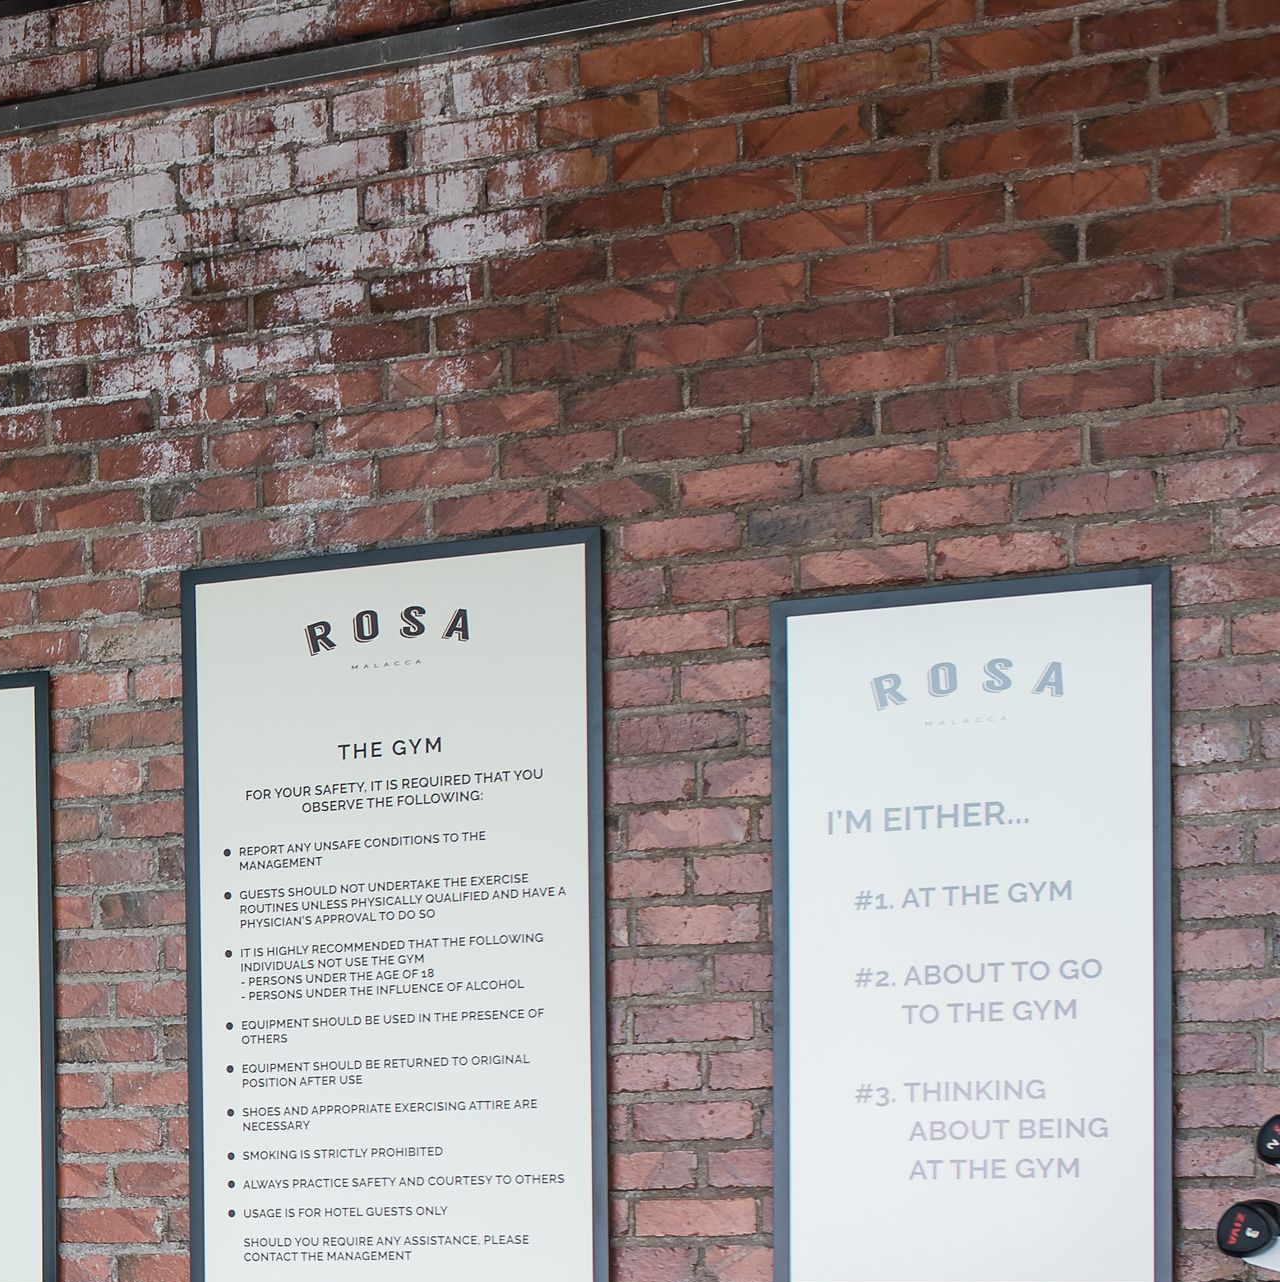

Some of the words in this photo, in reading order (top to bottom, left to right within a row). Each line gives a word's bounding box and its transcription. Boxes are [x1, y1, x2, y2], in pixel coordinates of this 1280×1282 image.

[304, 605, 469, 656] ROSA
[351, 659, 421, 669] MALACCA
[869, 657, 1064, 711] ROSA
[924, 716, 1006, 725] MALACCA
[337, 741, 382, 760] THE
[392, 736, 442, 755] GYM
[245, 788, 271, 801] FOR
[274, 785, 311, 798] YOUR
[314, 781, 367, 795] SAFETY,
[370, 780, 383, 791] IT
[386, 779, 398, 790] IS
[401, 773, 471, 789] REQUIRED
[473, 770, 511, 784] THAT
[513, 768, 543, 781] YOU
[301, 798, 364, 813] OBSERVE
[365, 795, 393, 808] THE
[396, 789, 483, 806] FOLLOWING:
[883, 800, 1029, 832] EITHER...
[239, 843, 285, 856] REPORT
[286, 842, 311, 853] ANY
[313, 838, 361, 851] UNSAFE
[363, 833, 439, 848] CONDITIONS
[441, 832, 459, 842] TO
[461, 830, 486, 841] THE
[239, 856, 323, 871] MANAGEMENT
[239, 887, 285, 900] GUESTS
[287, 884, 337, 897] SHOULD
[340, 882, 365, 894] NOT
[367, 878, 440, 892] UNDERTAKE
[442, 876, 467, 887] THE
[470, 872, 528, 886] EXERCISE
[853, 889, 894, 910] #1.
[900, 886, 936, 908] AT
[941, 883, 999, 906] THE
[1007, 879, 1072, 903] GYM
[239, 901, 298, 914] ROUTINES
[301, 898, 348, 910] UNLESS
[350, 894, 423, 908] PHYSICALLY
[425, 890, 489, 903] QUALIFIED
[492, 888, 519, 900] AND
[522, 886, 555, 898] HAVE
[557, 886, 566, 896] A
[314, 912, 377, 924] APPROVAL
[378, 910, 395, 920] TO
[398, 909, 416, 920] DO
[418, 908, 435, 919] SO
[240, 947, 251, 957] IT
[253, 947, 263, 957] IS
[266, 945, 309, 956] HIGHLY
[311, 939, 405, 954] RECOMMENDED
[407, 937, 439, 949] THAT
[441, 936, 466, 947] THE
[469, 932, 543, 946] FOLLOWING
[240, 959, 314, 972] INDIVIDUALS
[317, 957, 342, 968] NOT
[345, 956, 368, 967] USE
[370, 955, 395, 965] THE
[397, 953, 424, 964] GYM
[854, 967, 896, 987] #2.
[903, 961, 1005, 986] ABOUT
[1010, 960, 1050, 982] TO
[1058, 958, 1102, 980] GO
[248, 974, 303, 986] PERSONS
[305, 972, 346, 983] UNDER
[349, 970, 373, 981] THE
[375, 969, 399, 980] AGE
[402, 968, 418, 979] OF
[420, 968, 434, 978] 18
[248, 989, 303, 1000] PERSONS
[305, 986, 347, 998] UNDER
[349, 985, 373, 996] THE
[376, 982, 444, 995] INFLUENCE
[446, 981, 463, 991] OF
[465, 979, 525, 990] ALCOHOL
[241, 1017, 310, 1030] EQUIPMENT
[312, 1015, 362, 1027] SHOULD
[364, 1014, 380, 1025] BE
[383, 1013, 415, 1024] USED
[418, 1012, 431, 1023] IN
[433, 1011, 458, 1022] THE
[461, 1008, 524, 1021] PRESENCE
[527, 1007, 544, 1018] OF
[901, 1003, 940, 1024] TO
[946, 1001, 1004, 1023] THE
[1012, 998, 1077, 1021] GYM
[241, 1061, 310, 1073] EQUIPMENT
[312, 1059, 362, 1071] SHOULD
[365, 1059, 380, 1069] BE
[383, 1056, 449, 1068] RETURNED
[451, 1056, 468, 1066] TO
[470, 1053, 530, 1065] ORIGINAL
[242, 1076, 296, 1088] POSITION
[299, 1075, 336, 1086] AFTER
[339, 1074, 363, 1085] USE
[854, 1083, 896, 1107] #3.
[903, 1078, 1045, 1102] THINKING
[242, 1106, 280, 1117] SHOES
[283, 1105, 308, 1116] AND
[310, 1103, 391, 1115] APPROPRIATE
[394, 1100, 466, 1112] EXERCISING
[468, 1099, 511, 1110] ATTIRE
[513, 1098, 537, 1109] ARE
[242, 1120, 310, 1131] NECESSARY
[908, 1119, 1010, 1141] ABOUT
[1018, 1117, 1108, 1139] BEING
[908, 1159, 944, 1180] AT
[949, 1158, 1007, 1179] THE
[1015, 1157, 1080, 1178] GYM
[242, 1178, 289, 1189] ALWAYS
[292, 1177, 349, 1188] PRACTICE
[351, 1177, 396, 1187] SAFETY
[398, 1176, 424, 1186] AND
[427, 1175, 492, 1186] COURTESY
[495, 1174, 512, 1184] TO
[514, 1173, 565, 1184] OTHERS
[1226, 1212, 1246, 1245] ZIVA
[1245, 1227, 1260, 1238] 3
[243, 1237, 292, 1247] SHOULD
[294, 1237, 319, 1246] YOU
[322, 1236, 374, 1246] REQUIRE
[375, 1236, 401, 1246] ANY
[403, 1235, 480, 1246] ASSISTANCE,
[483, 1234, 529, 1244] PLEASE
